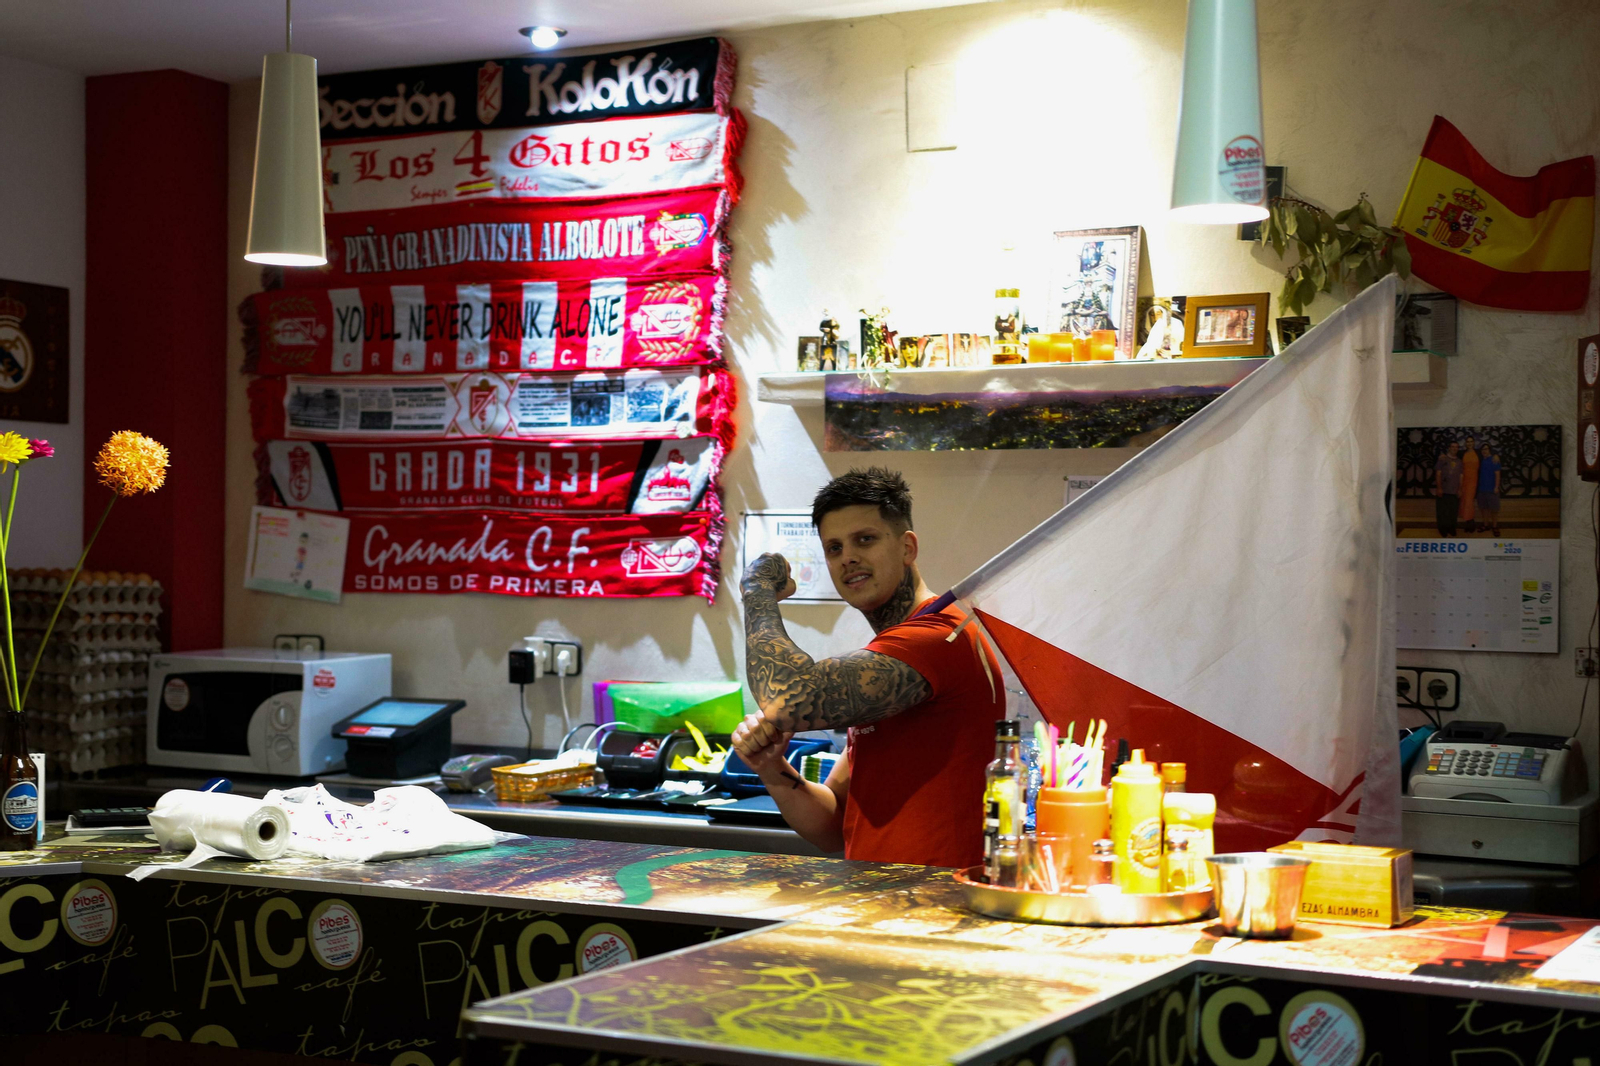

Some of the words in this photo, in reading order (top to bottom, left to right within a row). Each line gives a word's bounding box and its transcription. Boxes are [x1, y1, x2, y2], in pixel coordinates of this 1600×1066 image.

[350, 147, 437, 184] Los
[453, 129, 491, 178] 4
[508, 131, 653, 169] Gatos
[410, 185, 447, 204] Semper
[499, 176, 539, 193] Fidelis
[343, 225, 392, 274] PEÑA
[392, 222, 535, 271] GRANADINISTA
[538, 215, 646, 262] ALBOLOTE
[336, 303, 401, 343] YOU'LL
[408, 301, 474, 342] NEVER
[480, 301, 543, 339] DRINK
[549, 296, 621, 338] ALONE
[368, 448, 492, 492] GRADA
[515, 450, 600, 492] 1931
[399, 494, 455, 505] GRANADA
[460, 494, 492, 504] CLUB
[498, 495, 511, 505] DE
[517, 496, 563, 507] FUTBOL
[363, 514, 515, 574] Granada
[525, 525, 598, 574] C.F.
[1405, 542, 1468, 553] FEBRERO
[355, 574, 439, 590] SOMOS
[449, 573, 480, 589] DE
[489, 575, 605, 596] PRIMERA
[72, 893, 105, 909] Pibes
[1301, 902, 1324, 914] EZAS
[1327, 905, 1380, 918] ALHAMBRA
[319, 915, 350, 930] Pibes
[44, 923, 138, 997] café
[167, 897, 364, 1010] PALCO
[584, 936, 617, 961] Pibes
[293, 946, 388, 1024] café
[46, 999, 183, 1033] tapas
[295, 1024, 437, 1063] tapas
